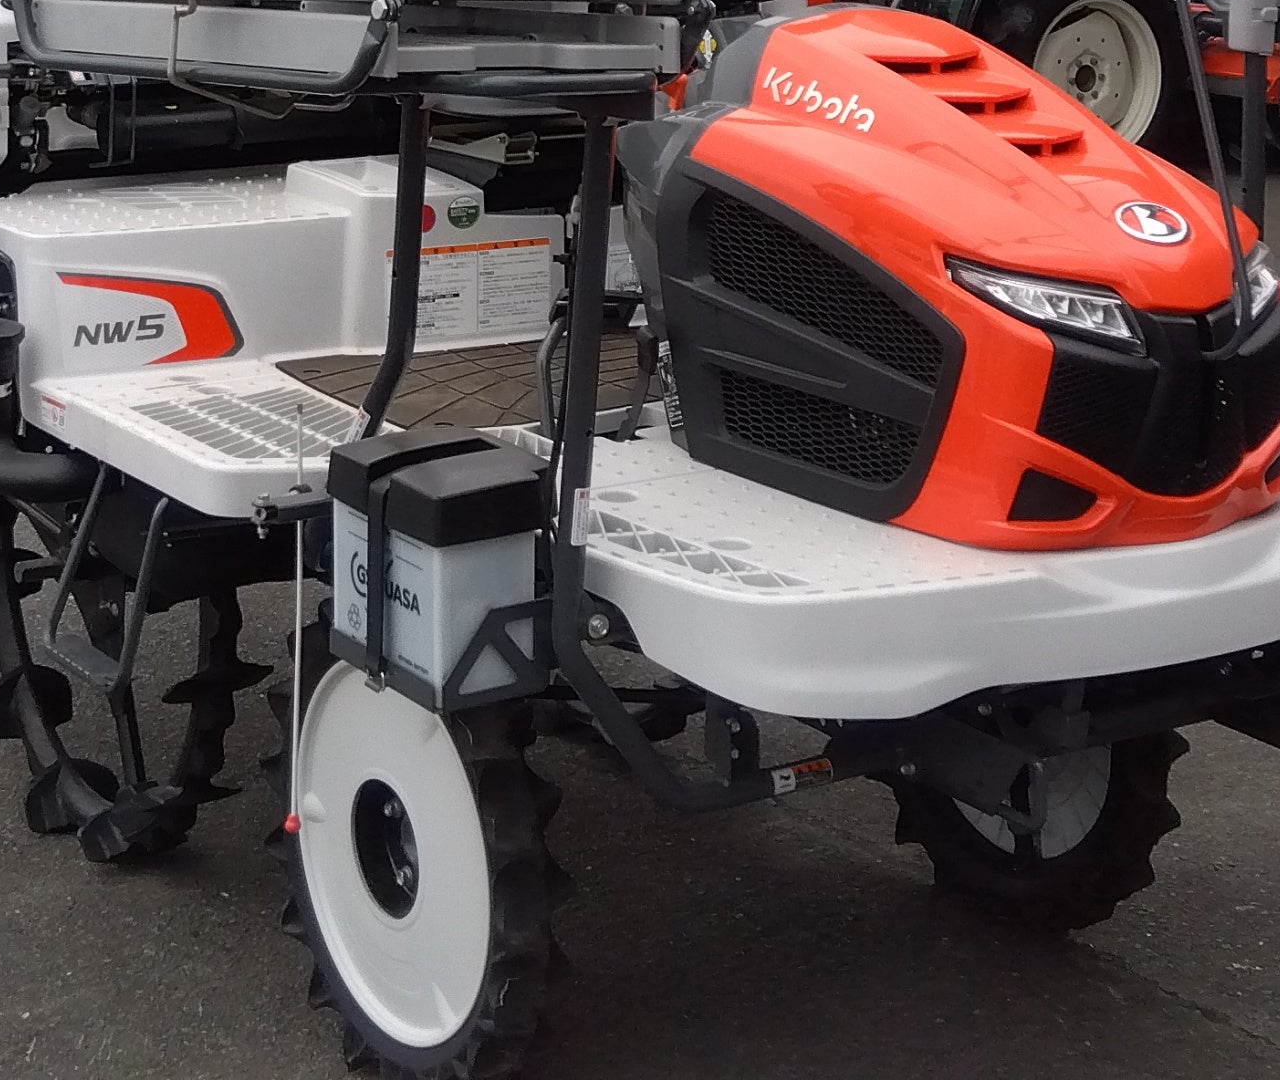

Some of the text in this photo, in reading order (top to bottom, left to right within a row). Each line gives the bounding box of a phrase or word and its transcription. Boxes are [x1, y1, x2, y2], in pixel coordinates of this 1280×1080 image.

[762, 66, 876, 133] Kubota
[73, 313, 166, 347] NW5
[383, 577, 421, 617] UASA
